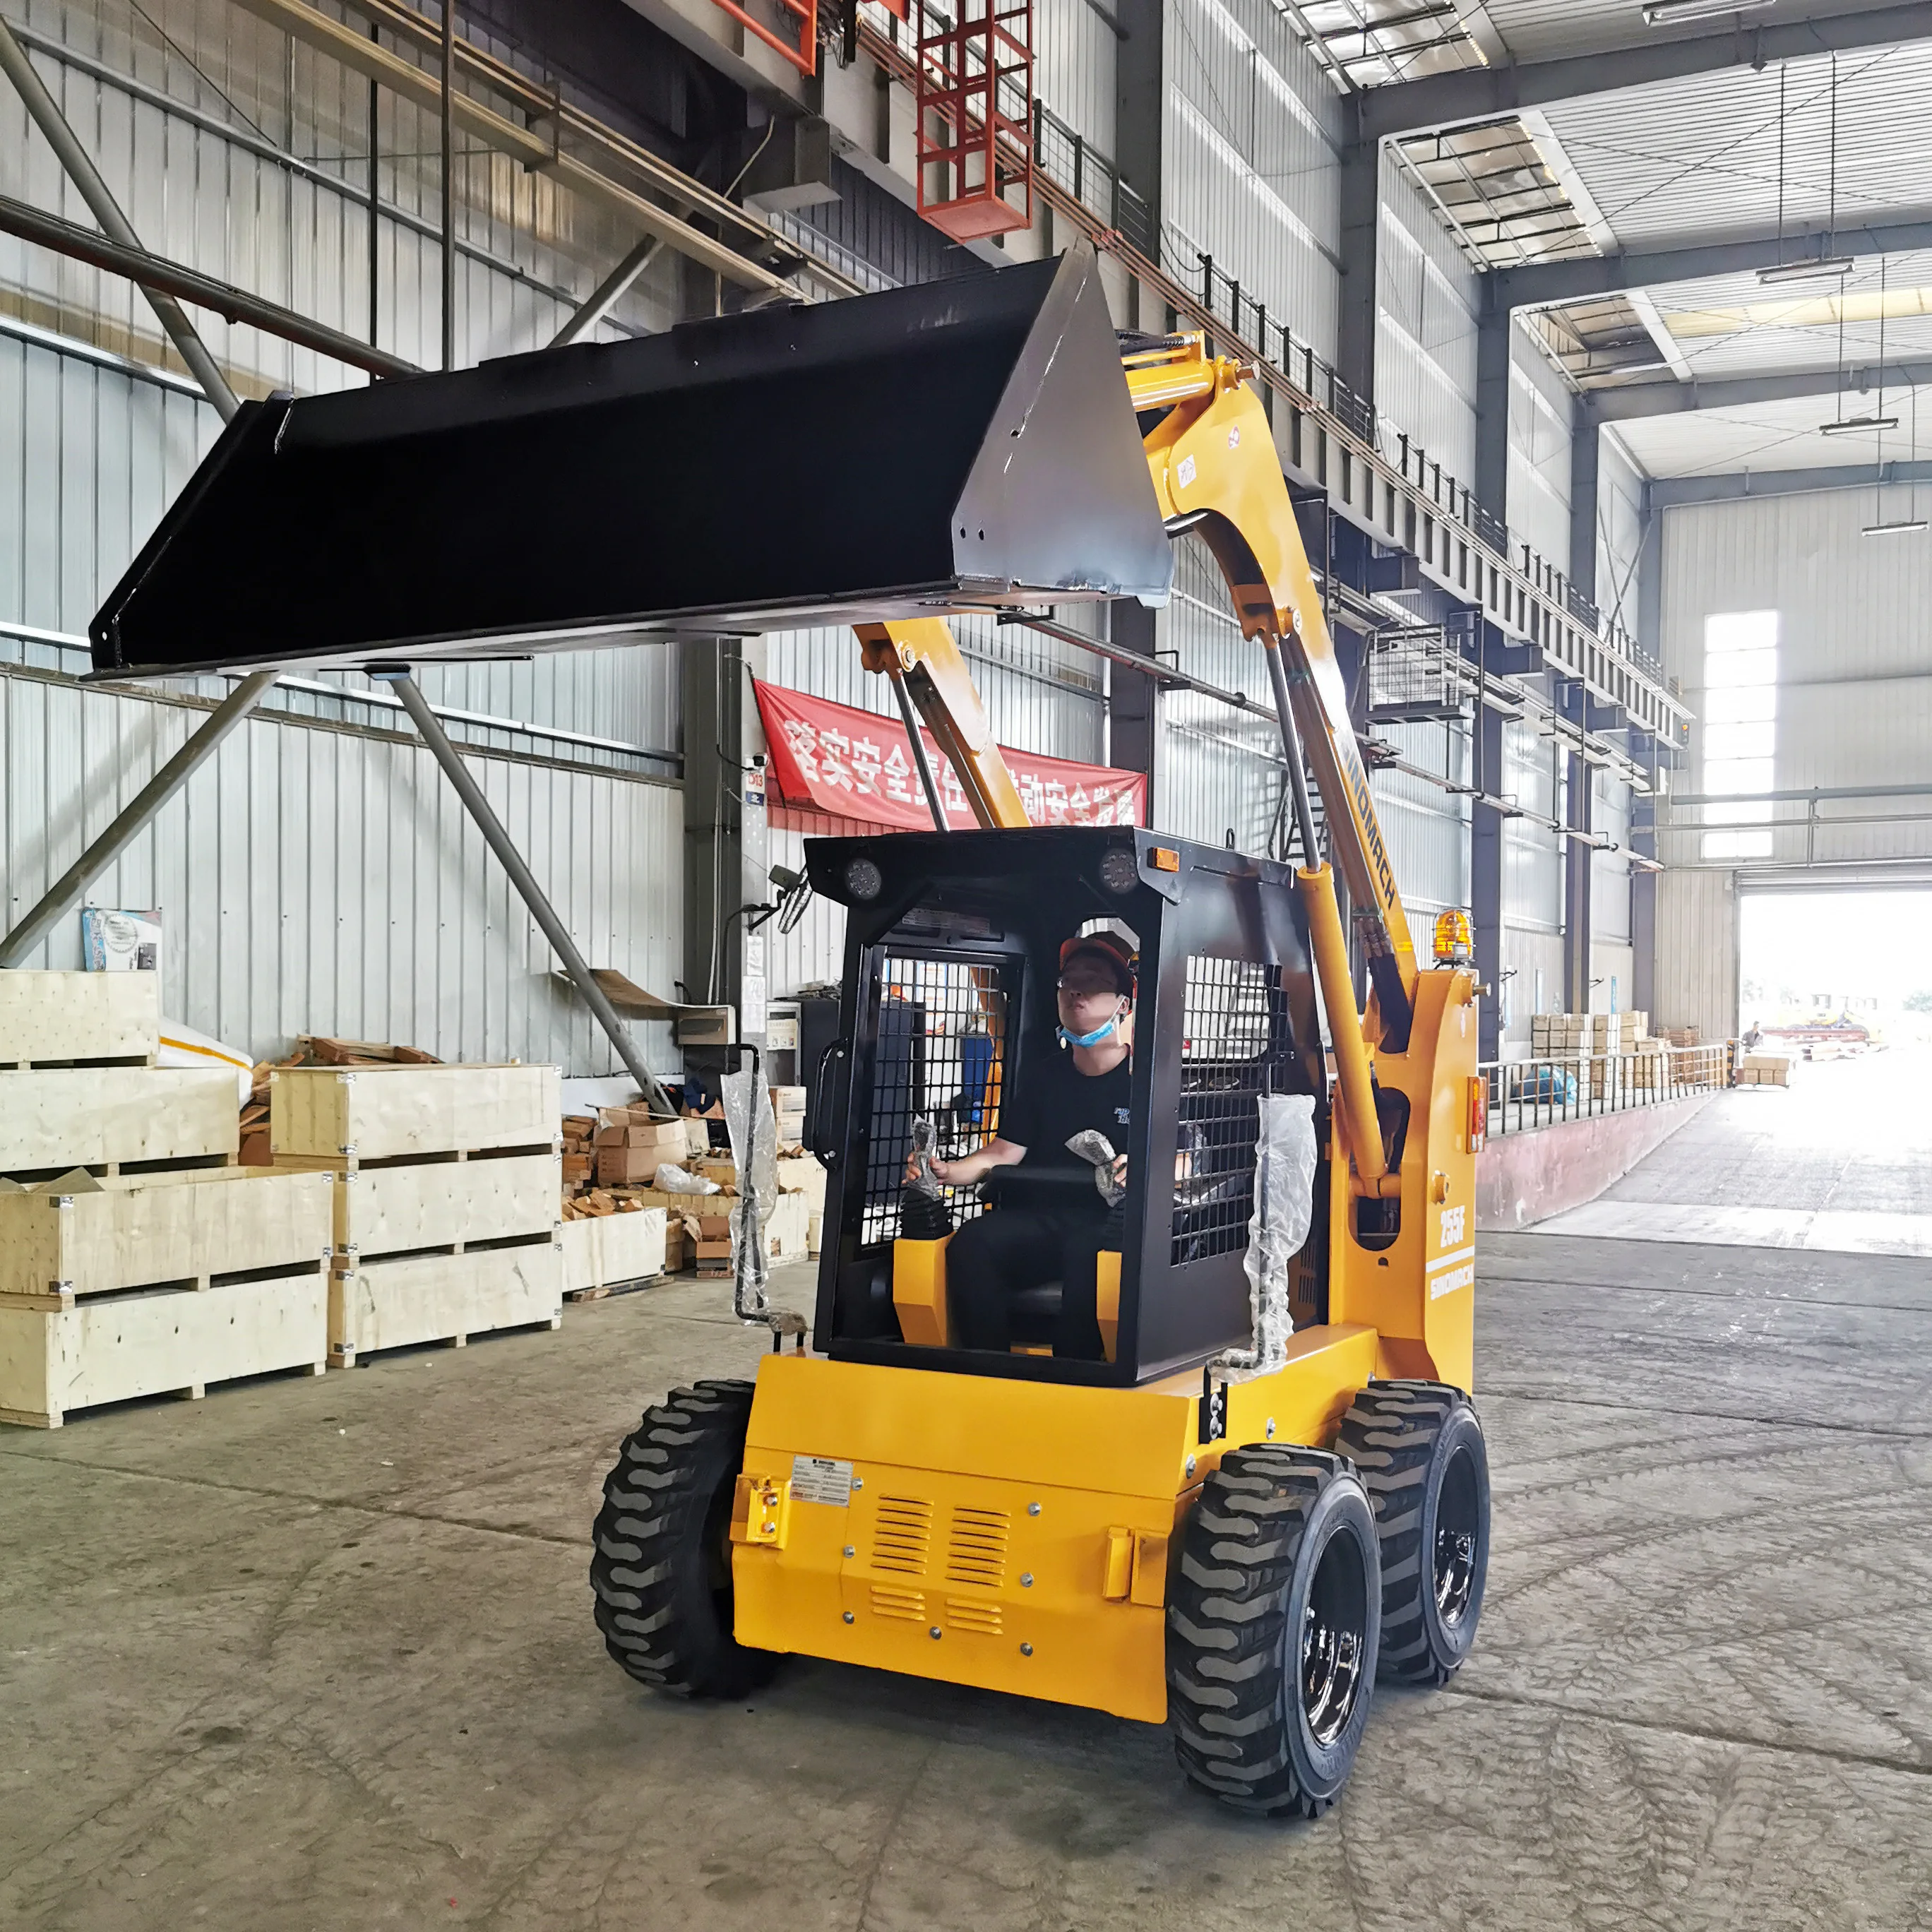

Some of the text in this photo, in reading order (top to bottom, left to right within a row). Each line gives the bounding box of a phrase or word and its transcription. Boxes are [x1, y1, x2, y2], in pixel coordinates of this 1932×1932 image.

[1006, 768, 1135, 826] 动安全发展
